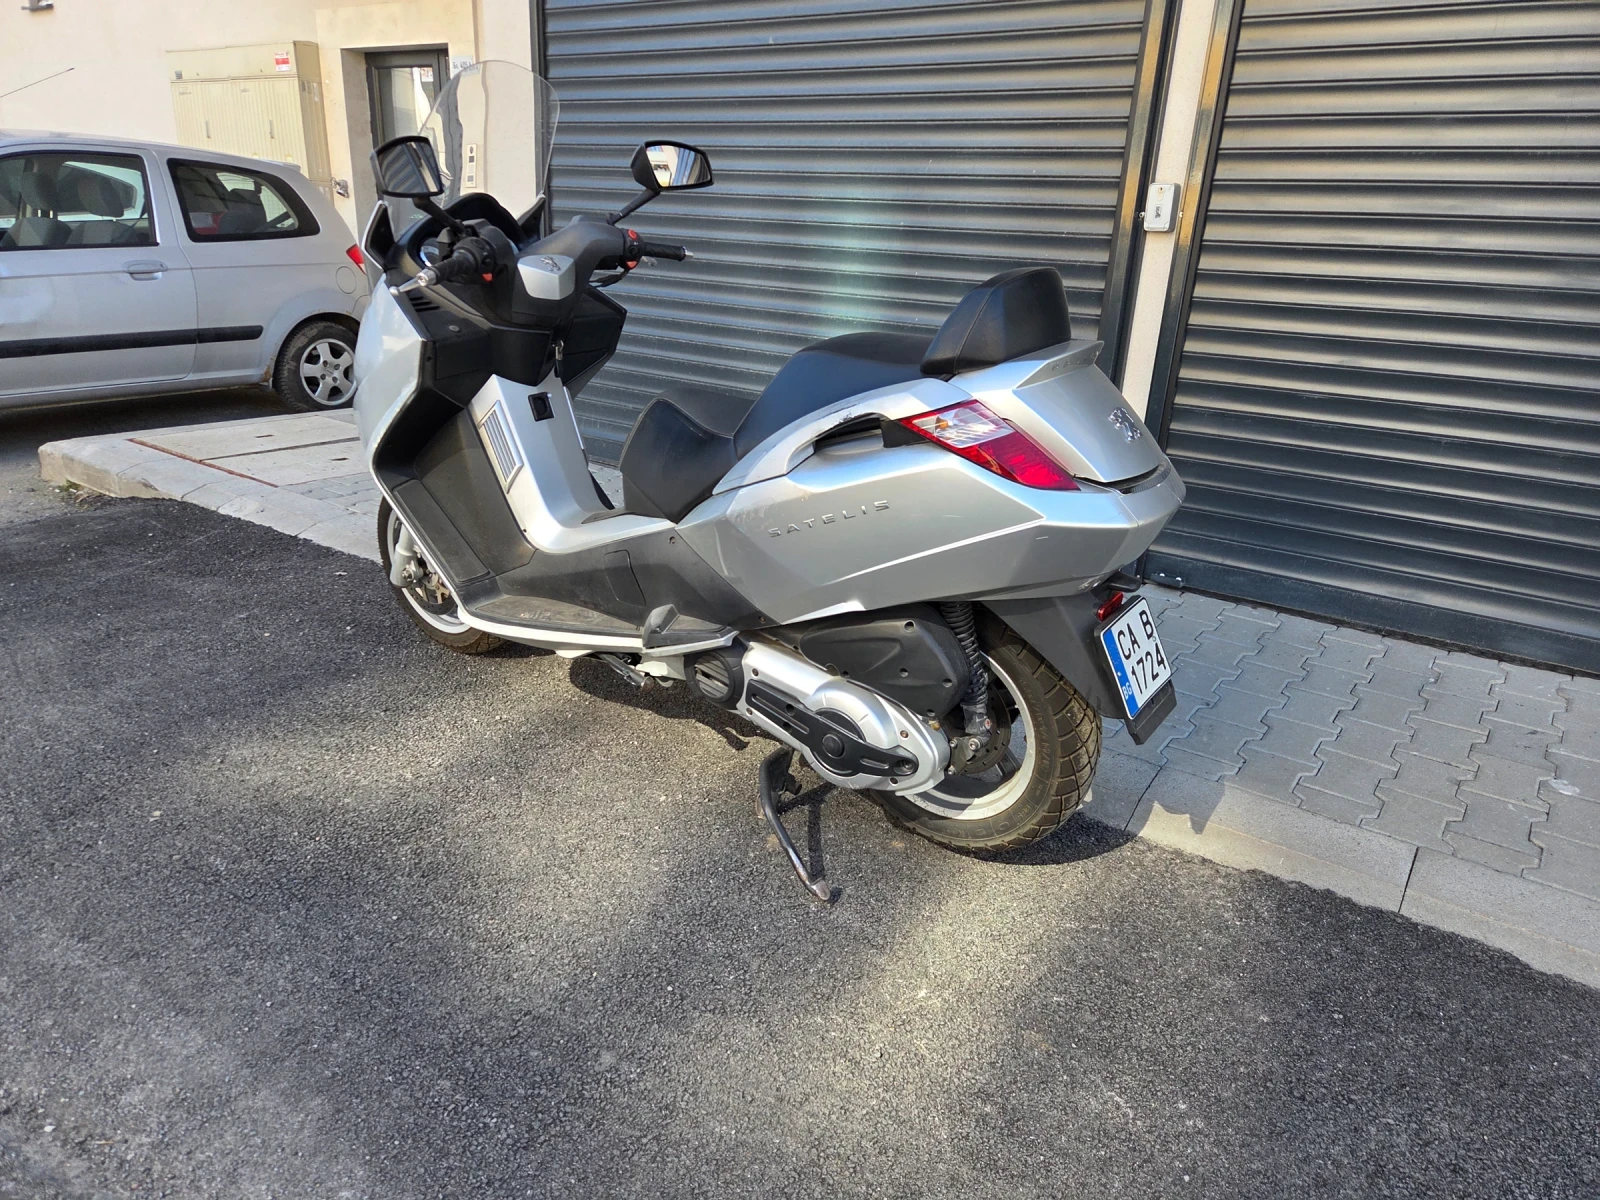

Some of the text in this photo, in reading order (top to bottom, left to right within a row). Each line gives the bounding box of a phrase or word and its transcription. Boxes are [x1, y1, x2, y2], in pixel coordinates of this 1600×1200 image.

[767, 499, 890, 538] SATELIS
[1117, 609, 1154, 661] CA B
[1121, 681, 1133, 700] BG
[1131, 642, 1166, 694] 1724
